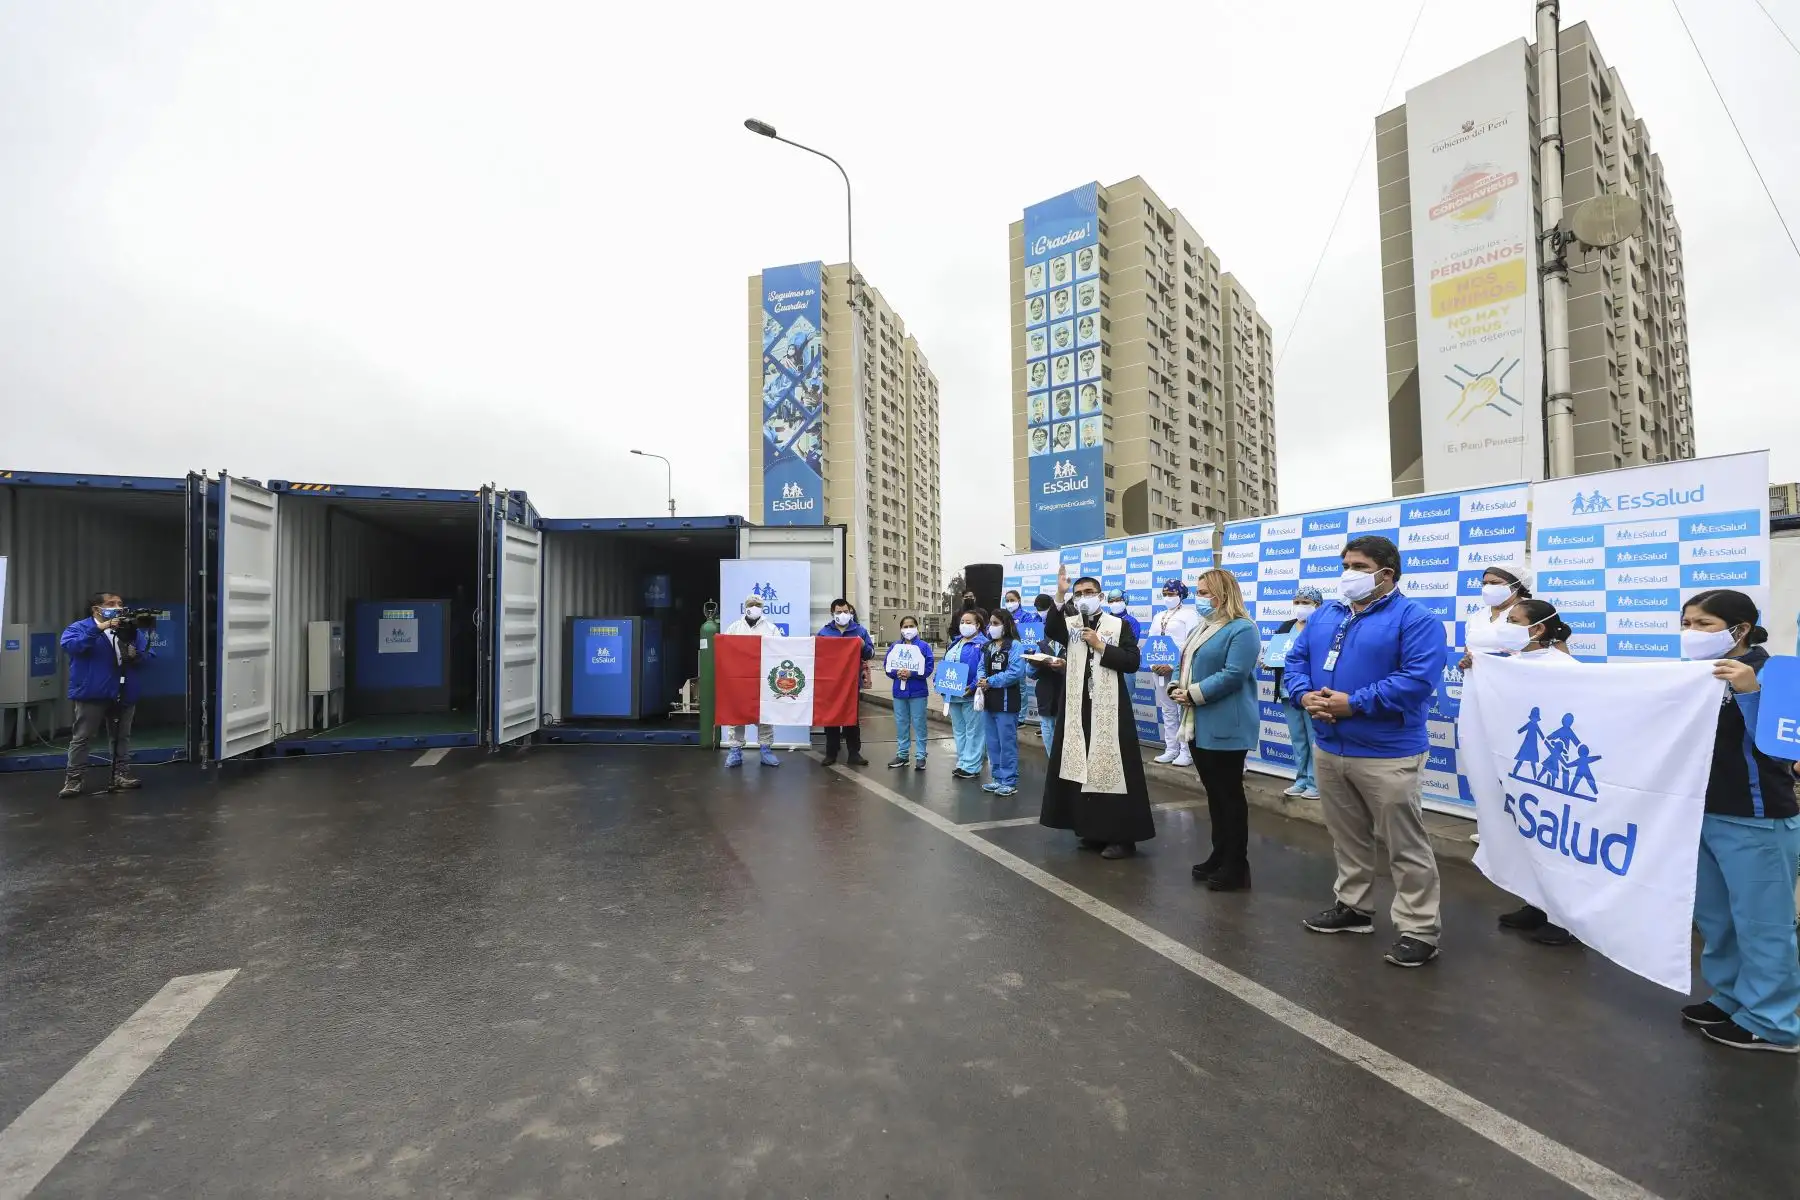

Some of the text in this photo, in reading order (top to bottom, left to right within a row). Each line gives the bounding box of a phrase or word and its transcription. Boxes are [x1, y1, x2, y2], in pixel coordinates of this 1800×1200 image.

[1432, 135, 1470, 153] Gobierno
[1472, 126, 1484, 138] del
[1433, 176, 1514, 216] CORONAVIRUS
[1032, 222, 1090, 256] ¡Gracias!
[1450, 244, 1485, 260] Cuando
[1430, 243, 1524, 280] PERUANOS
[1457, 272, 1498, 292] NOS
[1440, 281, 1517, 312] UNIMOS
[1448, 305, 1510, 329] NO HAY
[1456, 321, 1502, 338] VIRUS
[1043, 476, 1088, 494] EsSalud
[1617, 484, 1704, 511] EsSalud
[773, 498, 814, 511] EsSalud
[1486, 500, 1516, 510] EsSalud
[1423, 508, 1451, 517] EsSalud
[1367, 516, 1392, 524] EsSalud
[1320, 522, 1340, 530] EsSalud
[1484, 526, 1515, 536] EsSalud
[1709, 523, 1746, 533] EsSalud
[1422, 533, 1449, 541] EsSalud
[1634, 530, 1667, 538] EsSalud
[1564, 536, 1594, 544] EsSalud
[1634, 552, 1667, 561] EsSalud
[1709, 547, 1746, 556] EsSalud
[1421, 556, 1449, 566] EsSalud
[1484, 553, 1514, 562] EsSalud
[1634, 575, 1667, 583] EsSalud
[1710, 572, 1747, 580] EsSalud
[1420, 581, 1449, 590] EsSalud
[1634, 597, 1668, 606] EsSalud
[740, 602, 790, 615] alud
[1146, 653, 1175, 662] EsSalud
[891, 660, 919, 670] EsSalud
[938, 680, 963, 690] EsSalud
[1427, 730, 1446, 740] Salud
[1428, 755, 1446, 765] Salud
